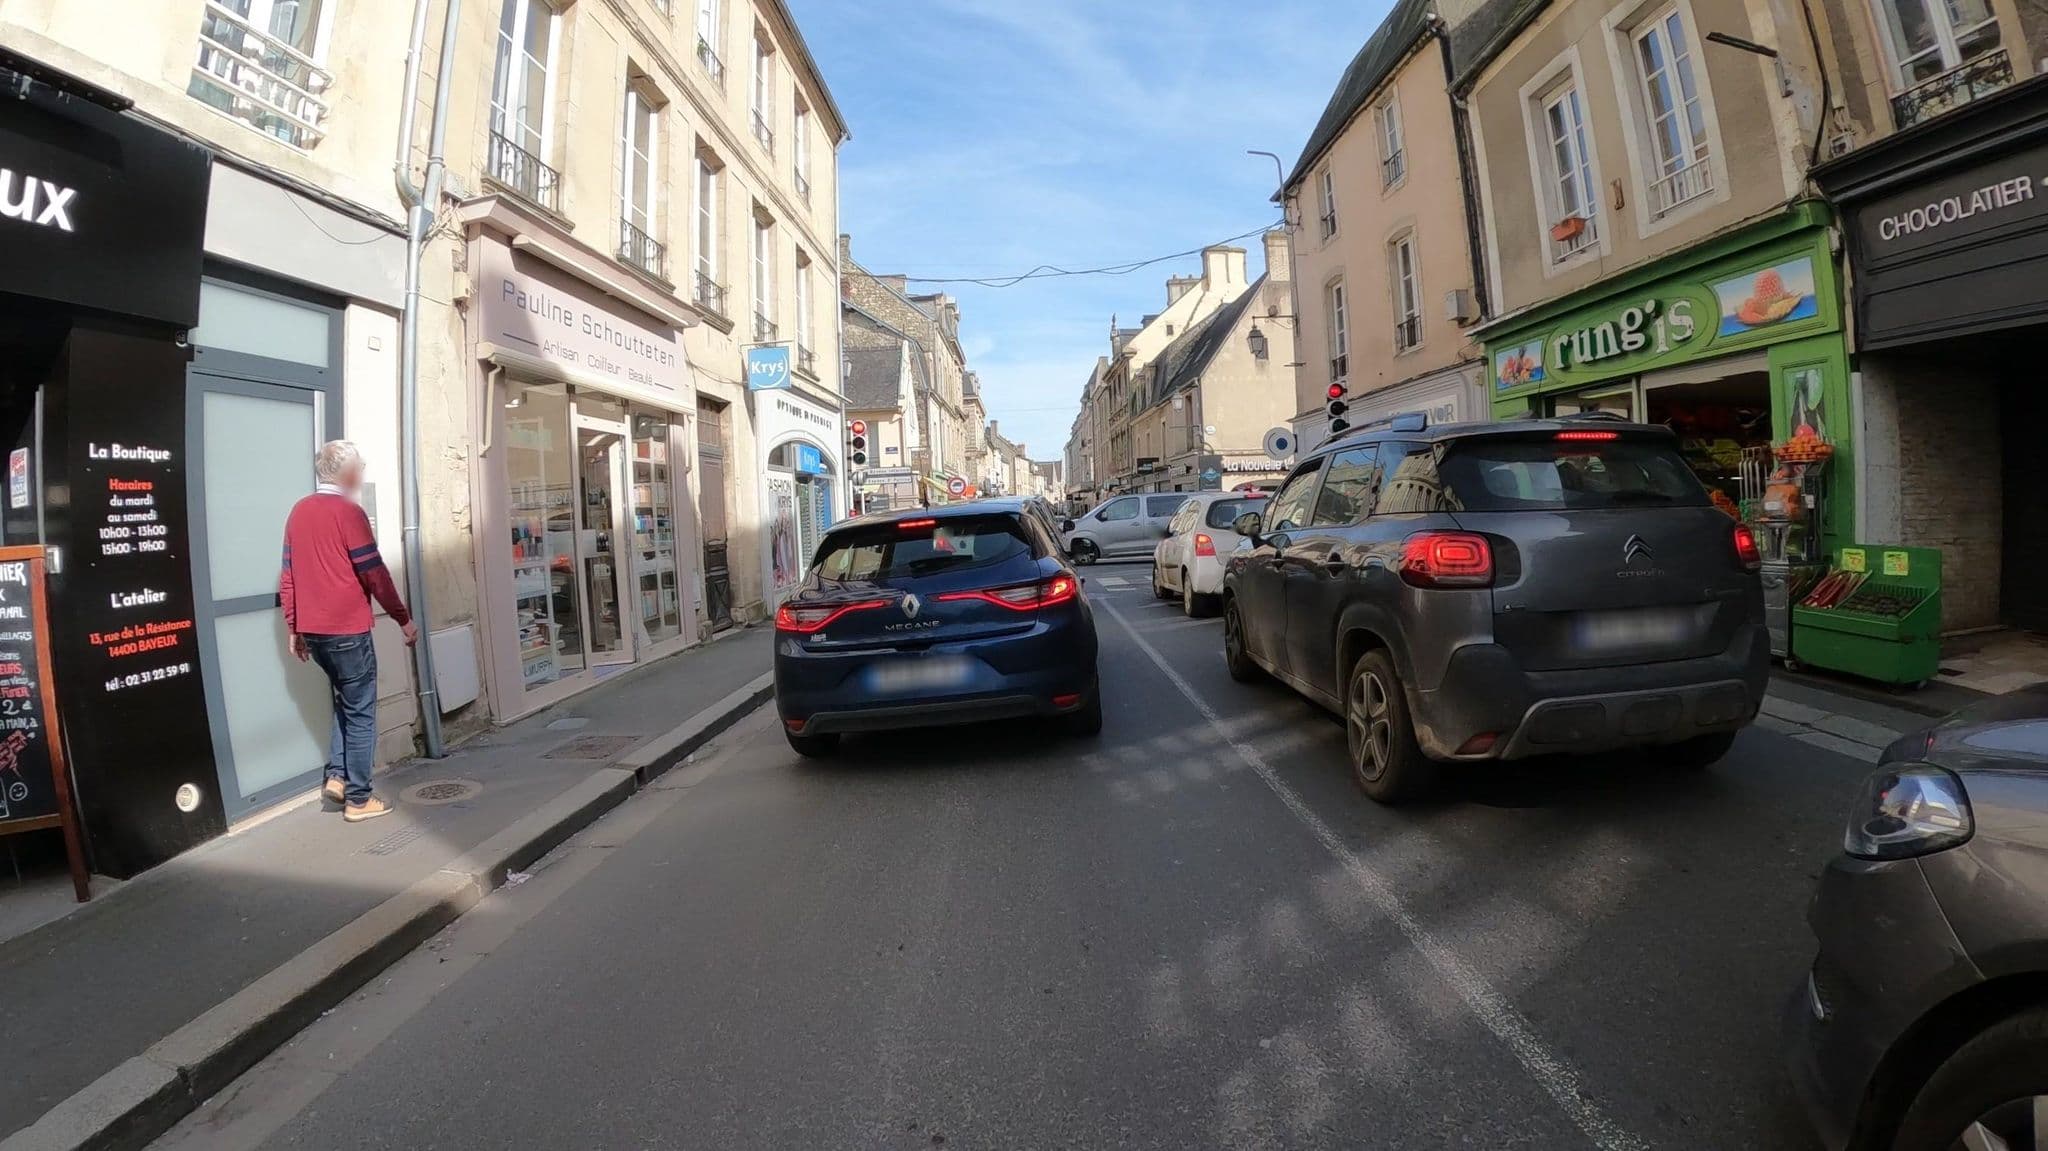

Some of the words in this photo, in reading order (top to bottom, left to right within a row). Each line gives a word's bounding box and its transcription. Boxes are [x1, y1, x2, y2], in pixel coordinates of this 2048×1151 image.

[1879, 175, 2035, 241] CHOCOLATIER
[502, 279, 573, 327] Pauline
[582, 313, 676, 368] Schoutteten
[1552, 299, 1696, 369] rungis
[543, 338, 580, 363] Artisan
[751, 361, 785, 377] Krys
[89, 442, 108, 459] La
[111, 443, 172, 463] Boutique
[109, 478, 153, 491] Horaires
[109, 494, 123, 507] du
[125, 493, 154, 506] mardi
[107, 513, 121, 523] au
[122, 508, 157, 522] samedi
[99, 526, 130, 539] 10h00
[137, 524, 168, 537] 13h00
[101, 542, 131, 555] 15h00
[138, 539, 167, 552] 19h00
[110, 587, 167, 608] L'atelier
[103, 631, 120, 642] rue
[121, 626, 134, 638] de
[134, 624, 145, 636] la
[145, 619, 192, 635] Résistance
[109, 642, 138, 657] 14400
[138, 634, 178, 651] BAYEUX
[125, 674, 139, 687] 02
[139, 671, 151, 683] 31
[152, 668, 165, 681] 22
[166, 665, 178, 677] 59
[179, 662, 190, 675] 91
